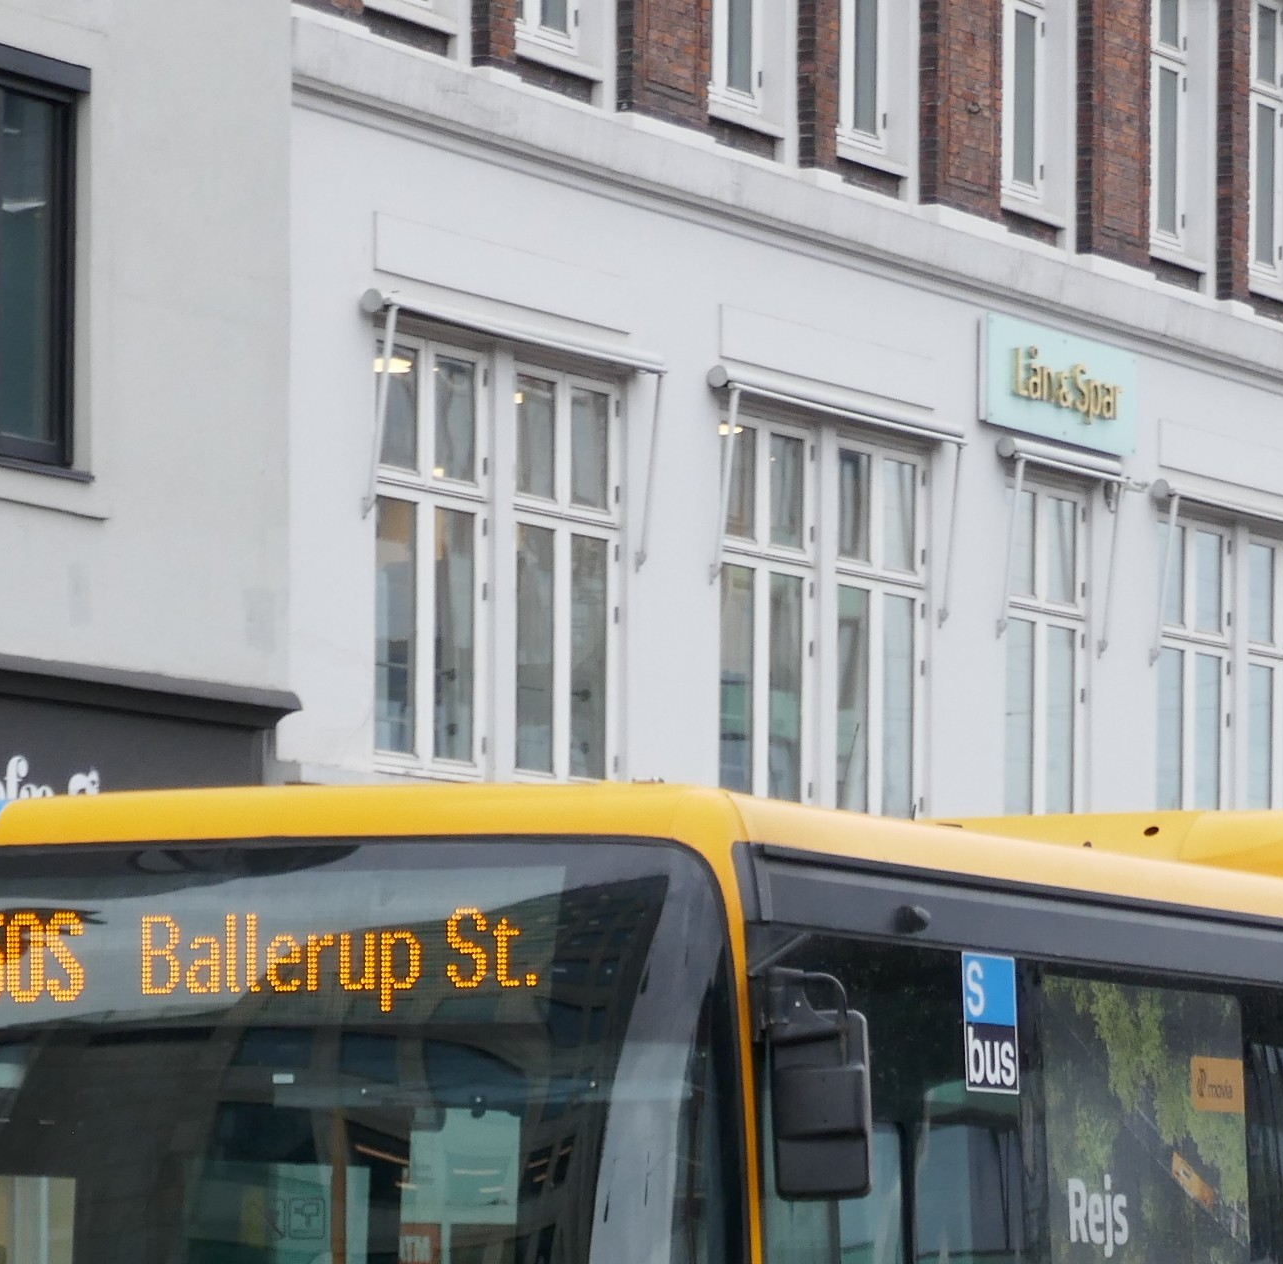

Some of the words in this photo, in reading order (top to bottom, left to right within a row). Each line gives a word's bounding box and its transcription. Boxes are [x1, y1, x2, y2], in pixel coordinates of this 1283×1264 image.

[141, 912, 422, 1013] Ballerup
[445, 906, 539, 990] St.
[966, 960, 985, 1017] S
[967, 1025, 1016, 1087] bus
[1067, 1173, 1128, 1258] Rejs
